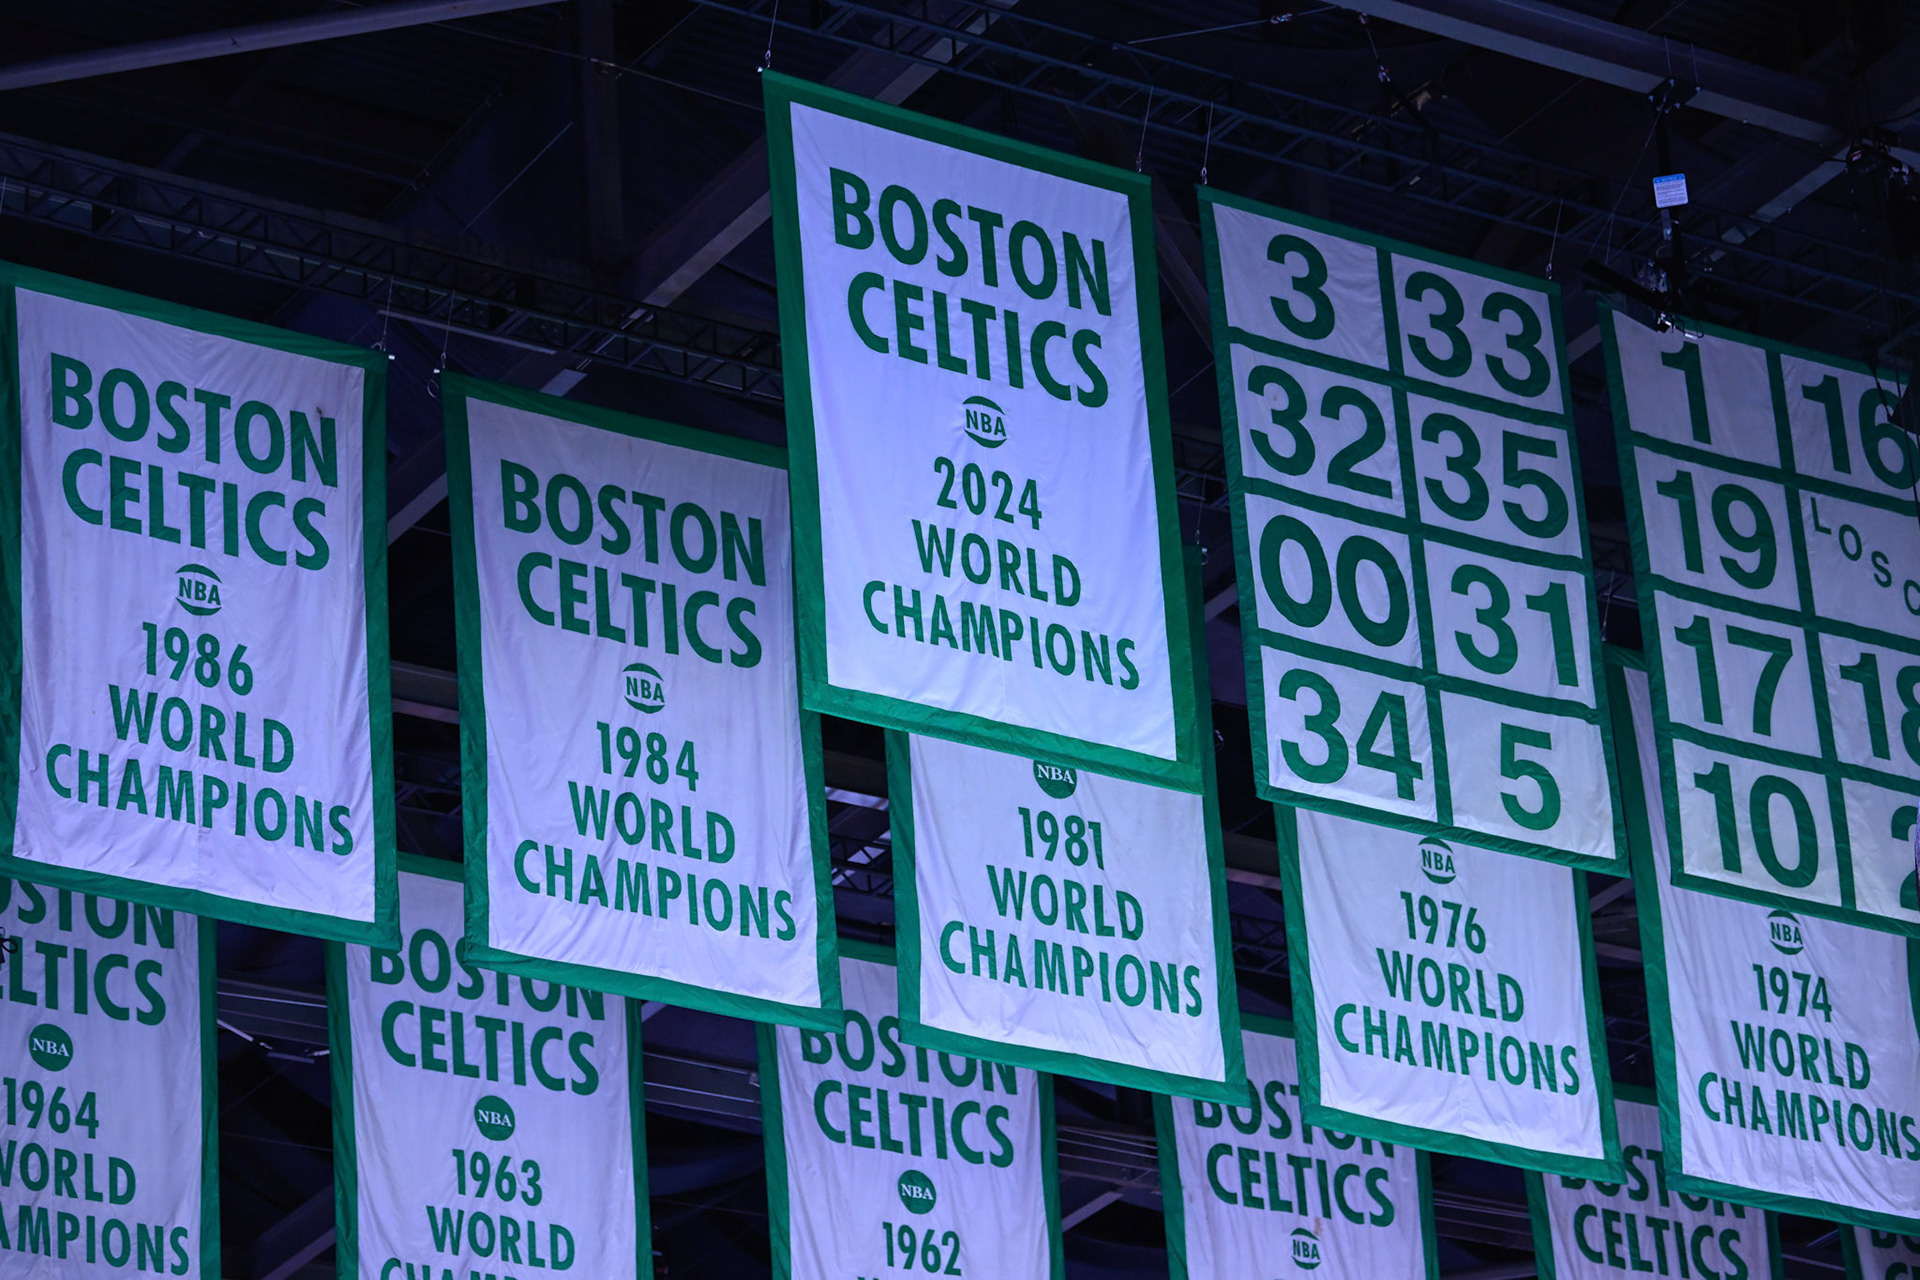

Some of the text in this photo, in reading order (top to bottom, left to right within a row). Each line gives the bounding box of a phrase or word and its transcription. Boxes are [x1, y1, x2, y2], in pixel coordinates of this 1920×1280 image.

[829, 167, 1112, 316] BOSTON
[1266, 233, 1335, 341] 3
[847, 271, 1108, 408] CELTICS
[1405, 271, 1551, 397] 33
[51, 352, 337, 488] BOSTON
[965, 410, 1006, 437] NBA
[1247, 364, 1393, 499] 32
[1661, 340, 1711, 445] 1
[1802, 375, 1920, 489] 16
[62, 449, 330, 571] CELTICS
[934, 456, 1042, 530] 2024
[1420, 412, 1569, 539] 35
[501, 459, 766, 587] BOSTON
[911, 520, 1081, 607] WORLD
[1656, 469, 1777, 590] 19
[178, 576, 221, 606] NBA
[517, 552, 762, 669] CELTICS
[1259, 514, 1409, 647] 00
[142, 622, 253, 696] 1986
[863, 580, 1139, 690] CHAMPIONS
[1451, 563, 1579, 687] 31
[626, 676, 665, 704] NBA
[1674, 614, 1793, 737] 17
[108, 685, 294, 773] WORLD
[596, 722, 699, 792] 1984
[1278, 668, 1422, 801] 34
[46, 744, 354, 856] CHAMPIONS
[1036, 764, 1075, 785] NBA
[1500, 723, 1561, 831] 5
[568, 781, 736, 864] WORLD
[1018, 807, 1104, 870] 1981
[1421, 848, 1456, 874] NBA
[1694, 761, 1818, 888] 10
[514, 839, 796, 941] CHAMPIONS
[986, 864, 1144, 941] WORLD
[1400, 891, 1486, 954] 1976
[1770, 922, 1803, 945] NBA
[0, 935, 166, 1026] LTICS
[940, 920, 1202, 1017] CHAMPIONS
[1376, 947, 1524, 1023] WORLD
[1752, 963, 1832, 1023] 1974
[33, 1038, 70, 1057] NBA
[381, 1000, 599, 1096] CELTICS
[1334, 1003, 1580, 1096] CHAMPIONS
[1730, 1020, 1870, 1090] WORLD
[3, 1077, 99, 1139] 1964
[478, 1109, 514, 1129] NBA
[814, 1079, 1014, 1168] CELTICS
[1699, 1072, 1920, 1162] CHAMPIONS
[451, 1149, 542, 1206] 1963
[901, 1183, 933, 1200] NBA
[1206, 1142, 1394, 1227] CELTICS
[426, 1205, 575, 1271] WORLD
[882, 1221, 962, 1276] 1962
[1293, 1239, 1320, 1260] NBA
[1573, 1204, 1748, 1280] CELTICS
